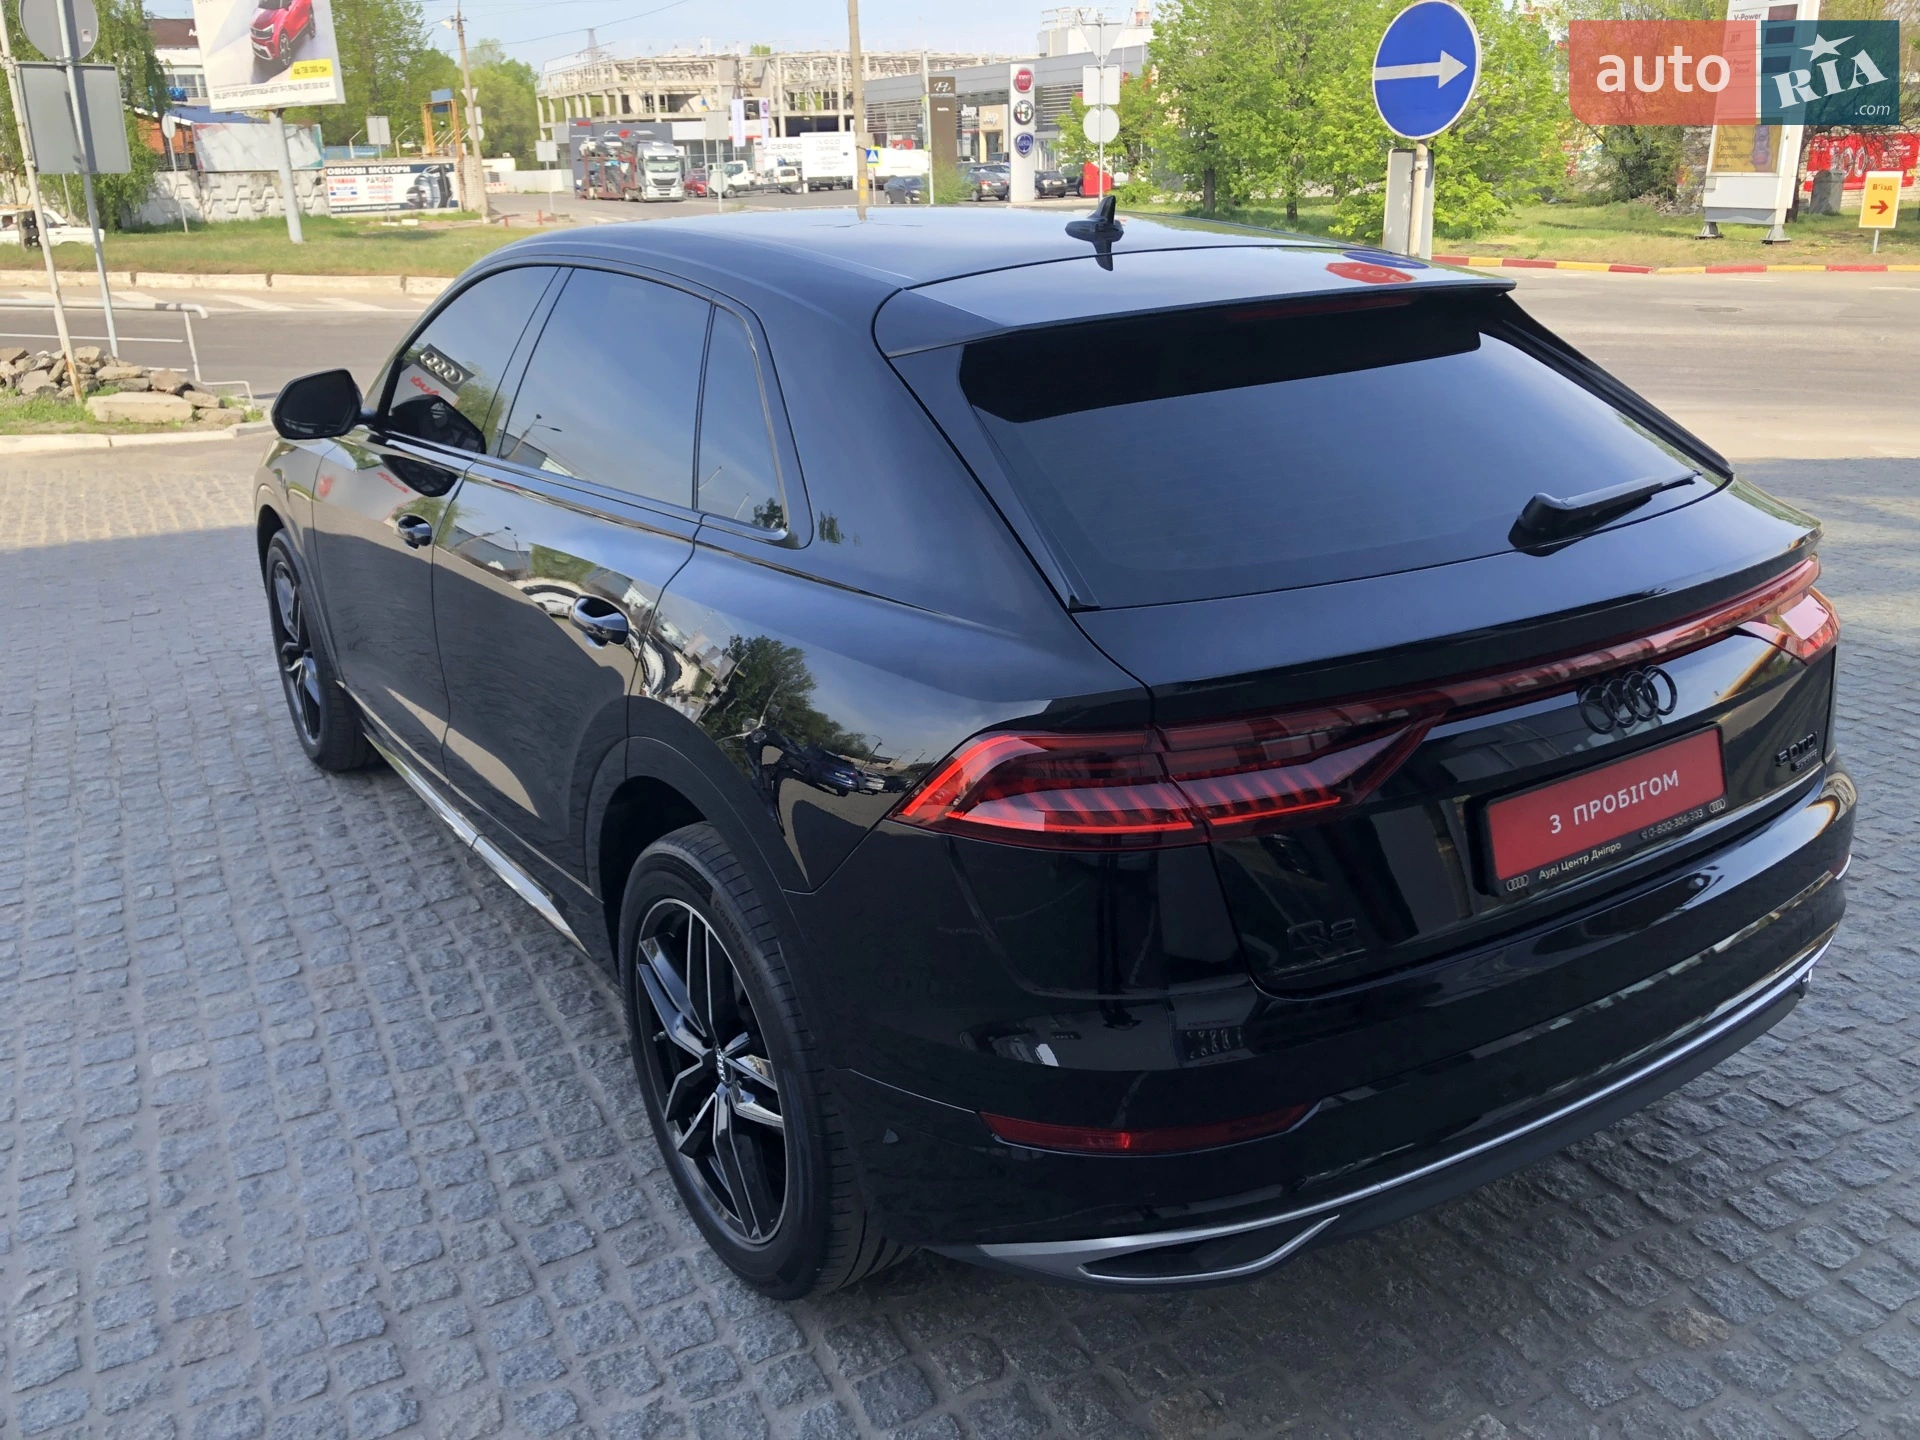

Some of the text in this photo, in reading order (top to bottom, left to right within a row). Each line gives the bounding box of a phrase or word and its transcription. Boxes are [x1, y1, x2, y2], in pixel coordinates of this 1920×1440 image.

[1573, 769, 1680, 825] ПРОБІГОМ
[1538, 842, 1622, 879] Ауді Центр Дніпро
